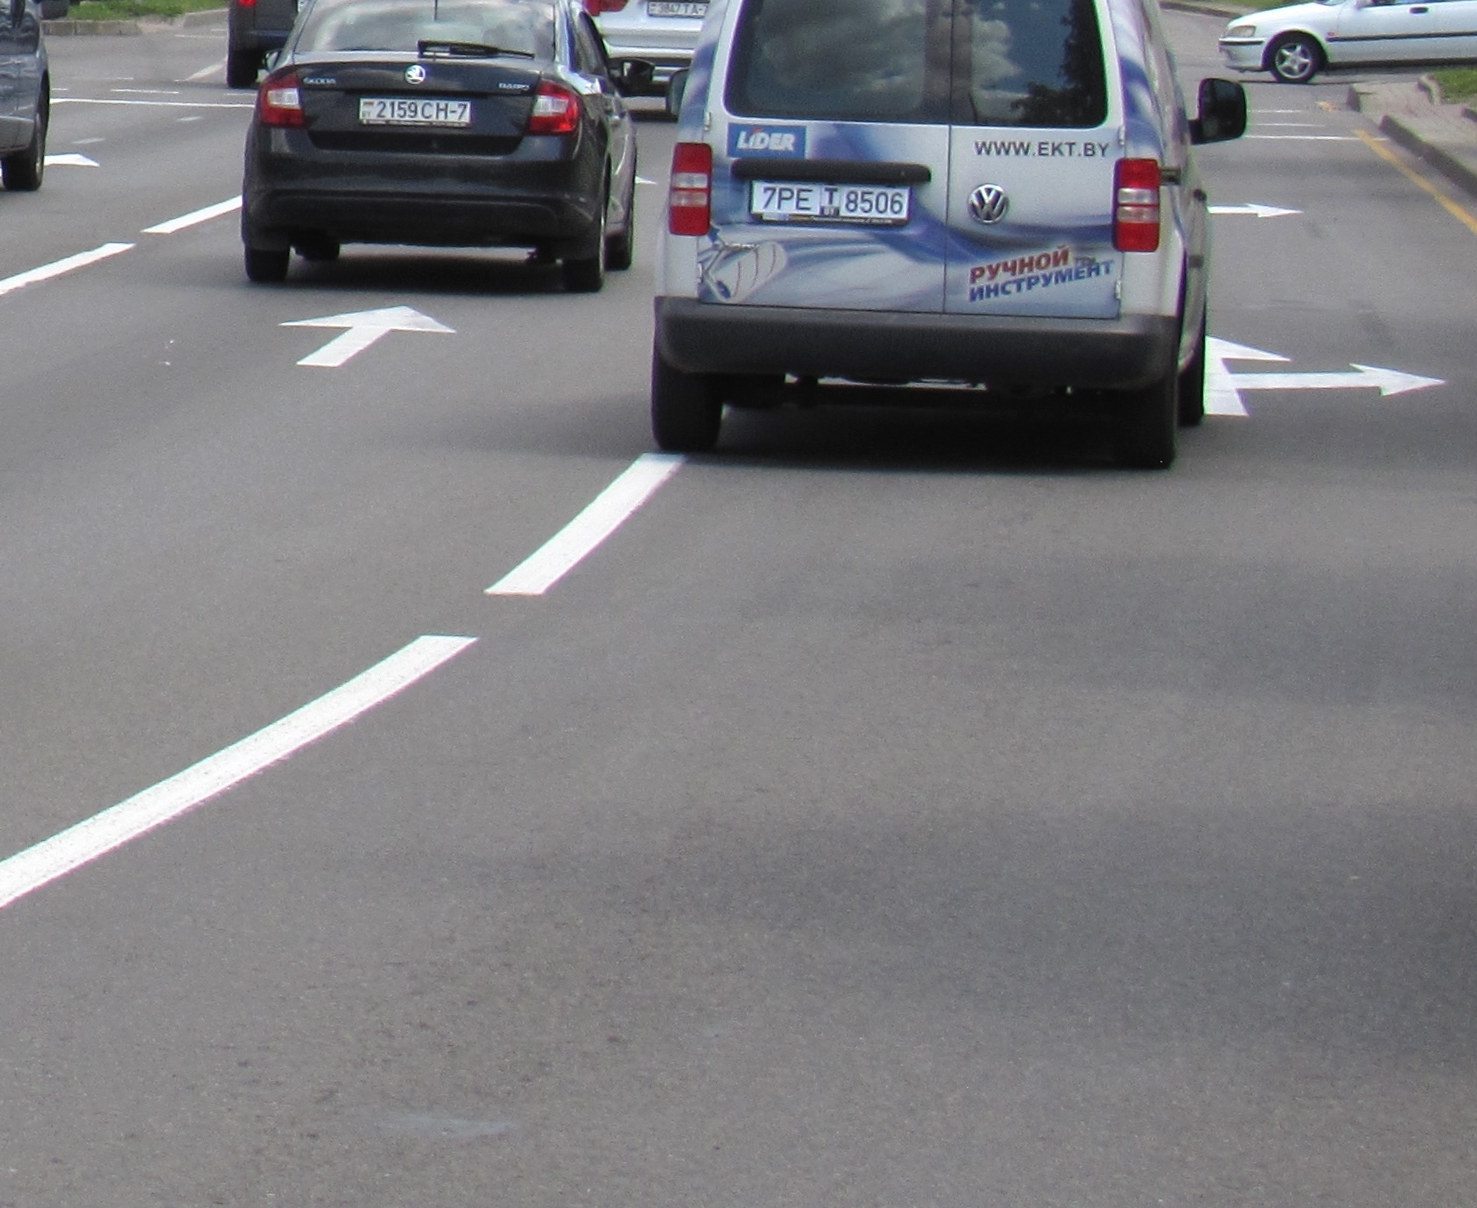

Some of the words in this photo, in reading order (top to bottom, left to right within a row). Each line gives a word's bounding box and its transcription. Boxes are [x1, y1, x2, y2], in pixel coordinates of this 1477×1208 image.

[975, 142, 1110, 158] WWW.EKT.BY
[763, 187, 813, 211] 7PE
[846, 191, 903, 215] 8506
[970, 244, 1070, 284] РУЧНОЙ
[969, 260, 1116, 303] ИНСТРУМЕНТ
